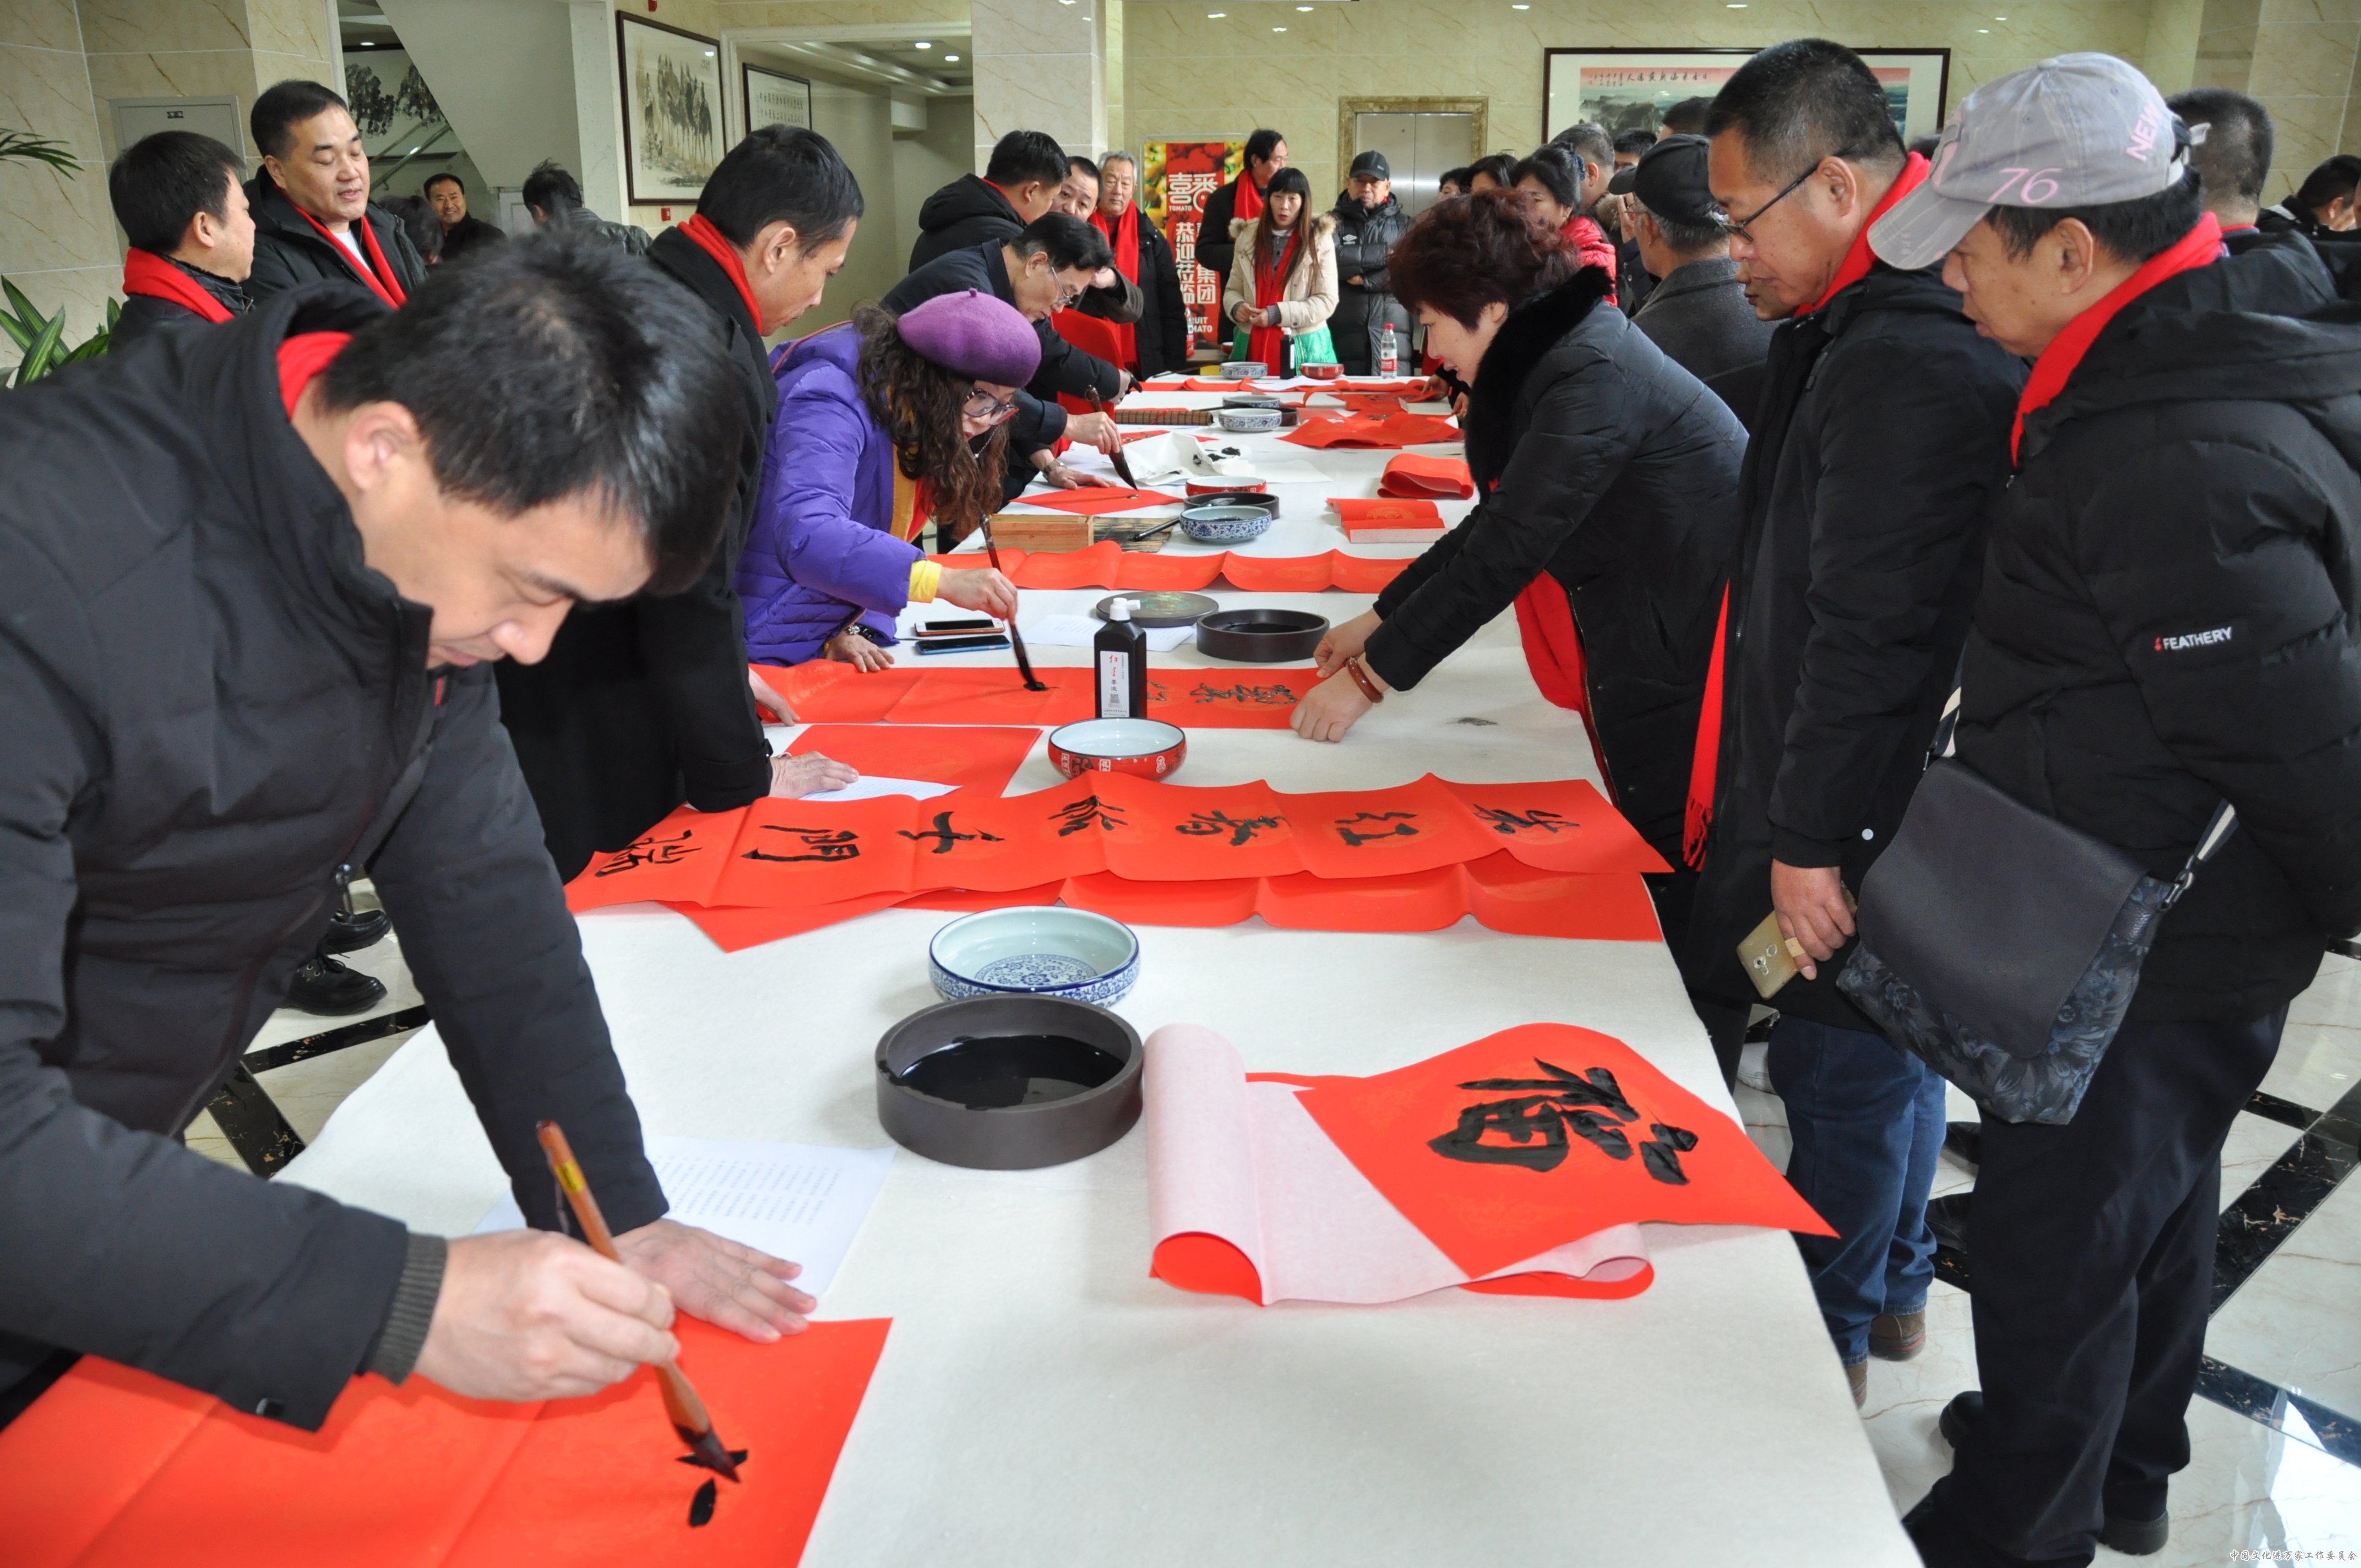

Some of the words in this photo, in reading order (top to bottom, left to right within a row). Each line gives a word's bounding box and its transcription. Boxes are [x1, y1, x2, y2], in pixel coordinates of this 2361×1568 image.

[2125, 100, 2163, 162] NEW
[1987, 167, 2064, 204] 76
[2162, 627, 2232, 650] FEATHERY
[1427, 1057, 1699, 1185] 福
